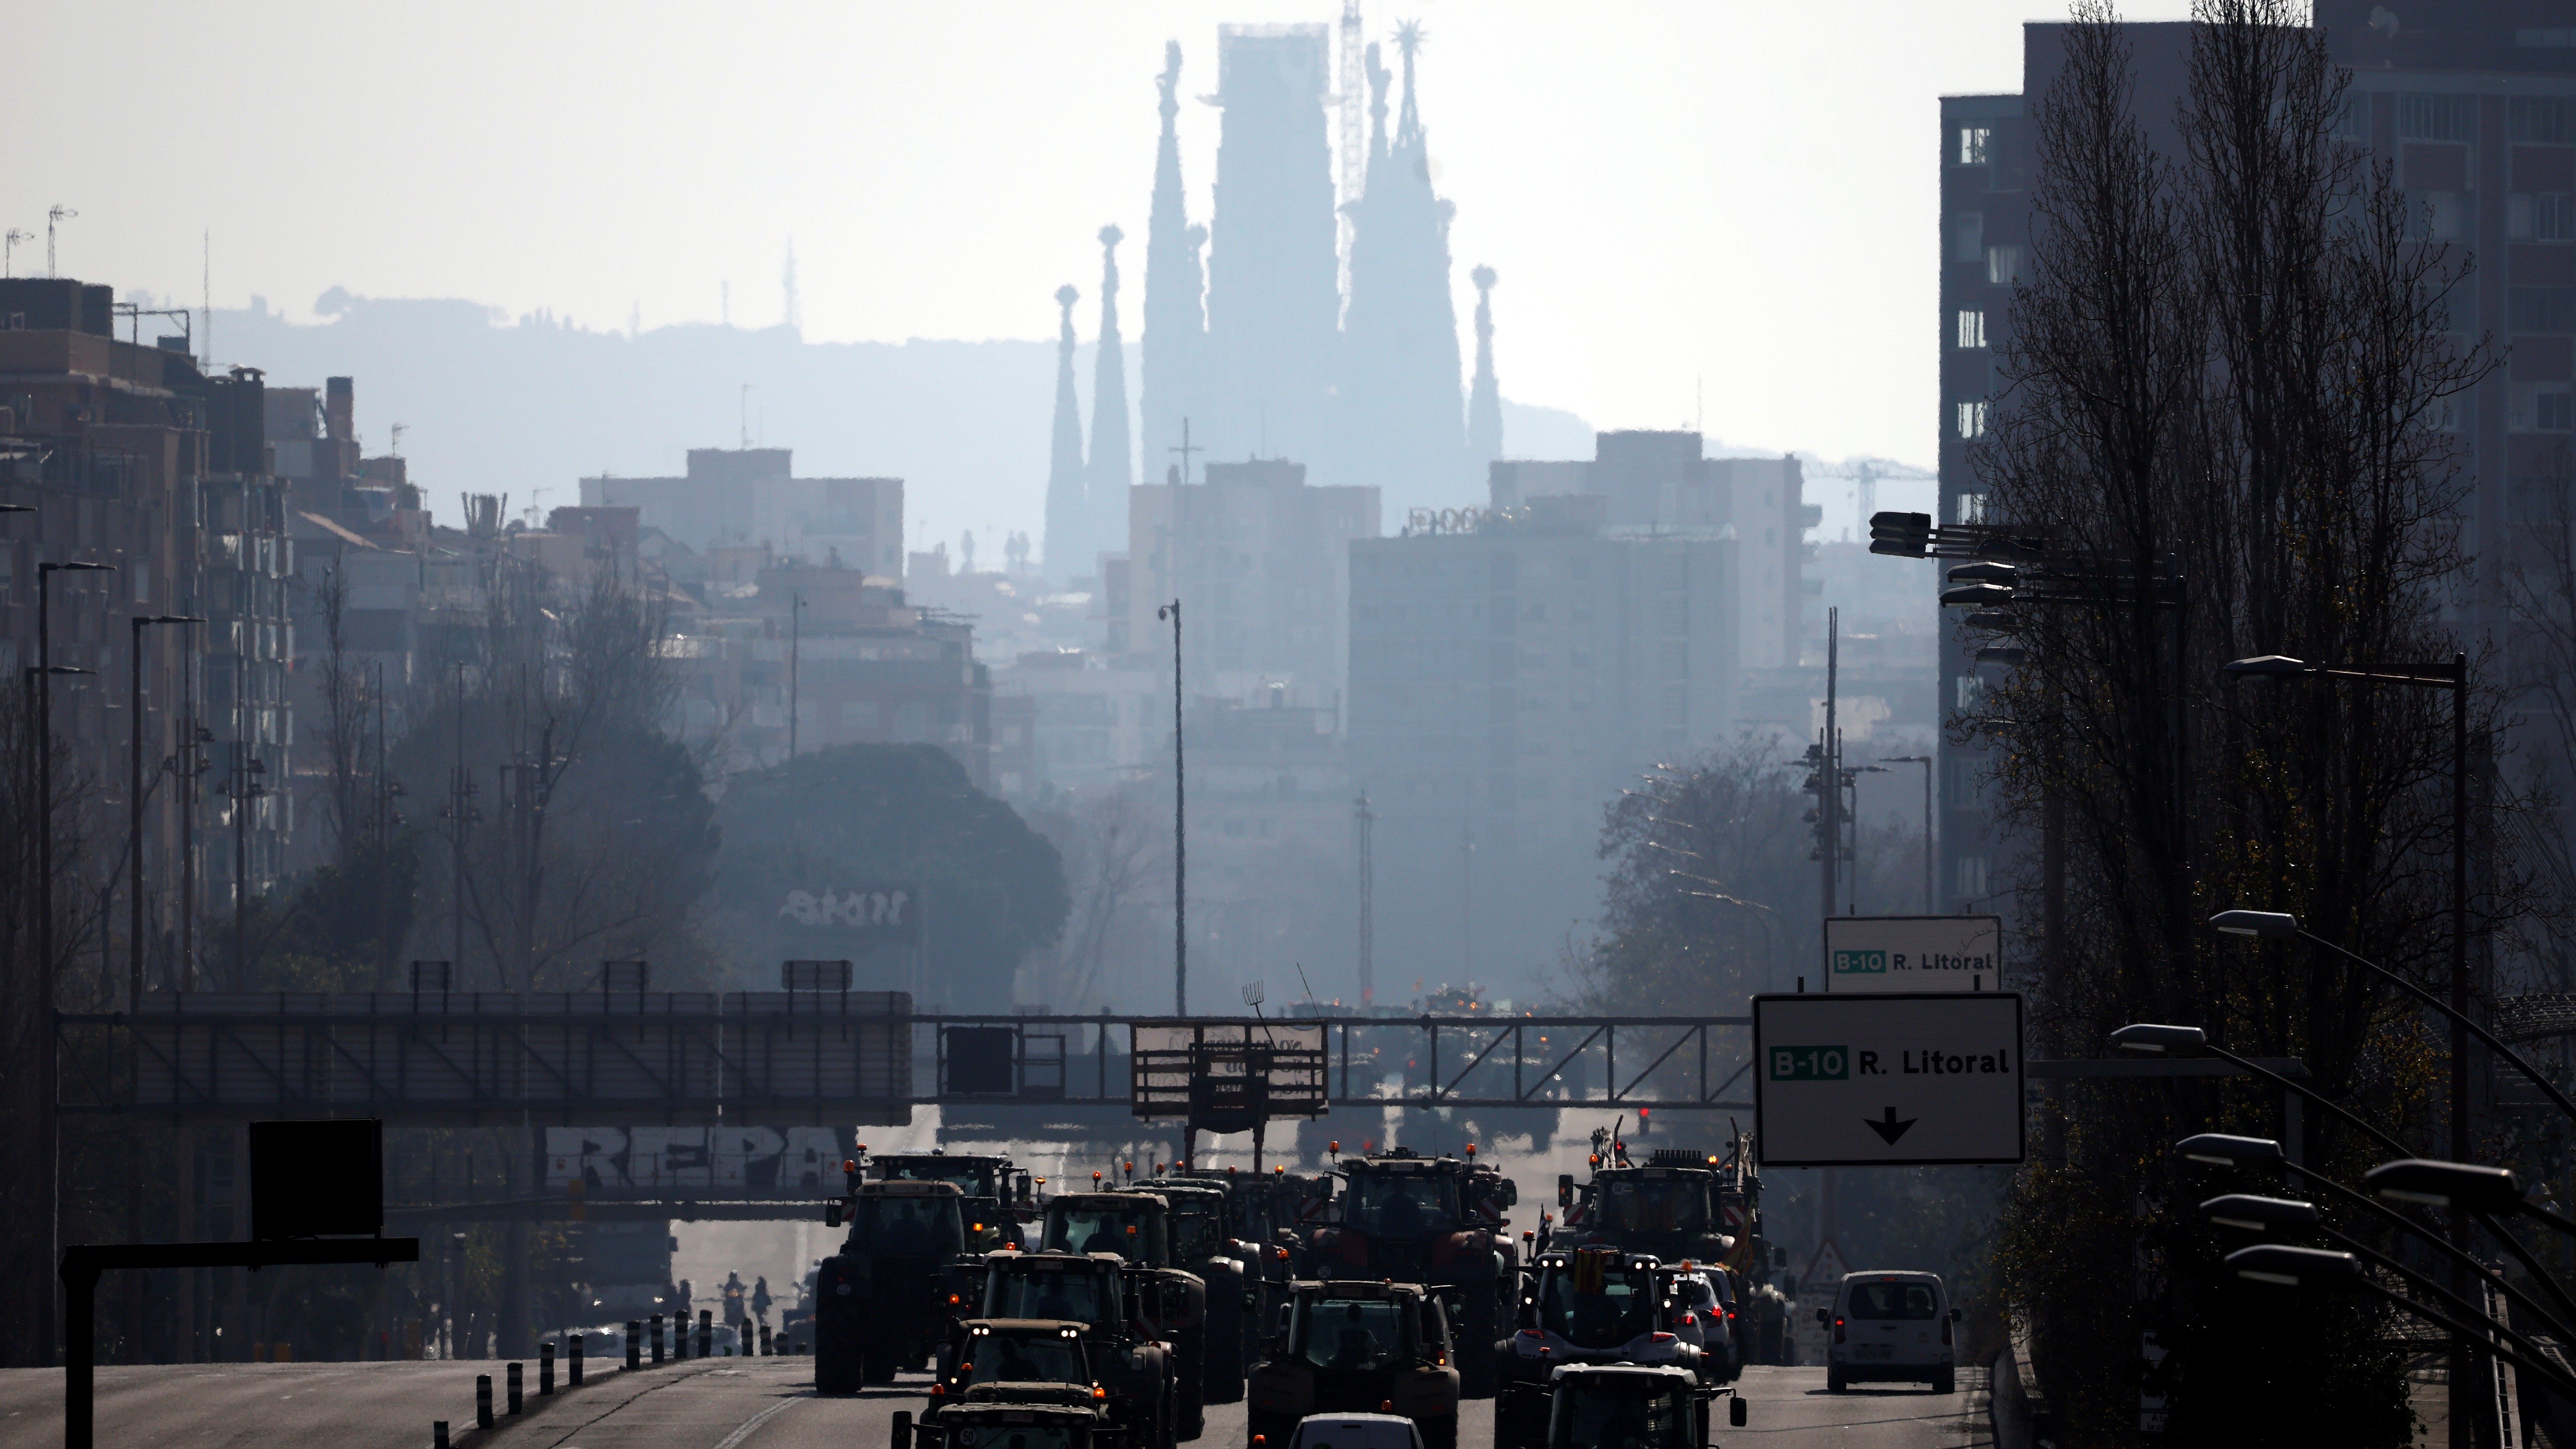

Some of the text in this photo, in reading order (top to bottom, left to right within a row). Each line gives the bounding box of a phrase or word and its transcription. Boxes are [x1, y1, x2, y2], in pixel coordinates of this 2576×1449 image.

[1837, 953, 1993, 971] B-10 R. Litoral
[1775, 1049, 2009, 1076] B-10 R. Litoral
[546, 1125, 848, 1188] REPA
[963, 1431, 973, 1442] 50
